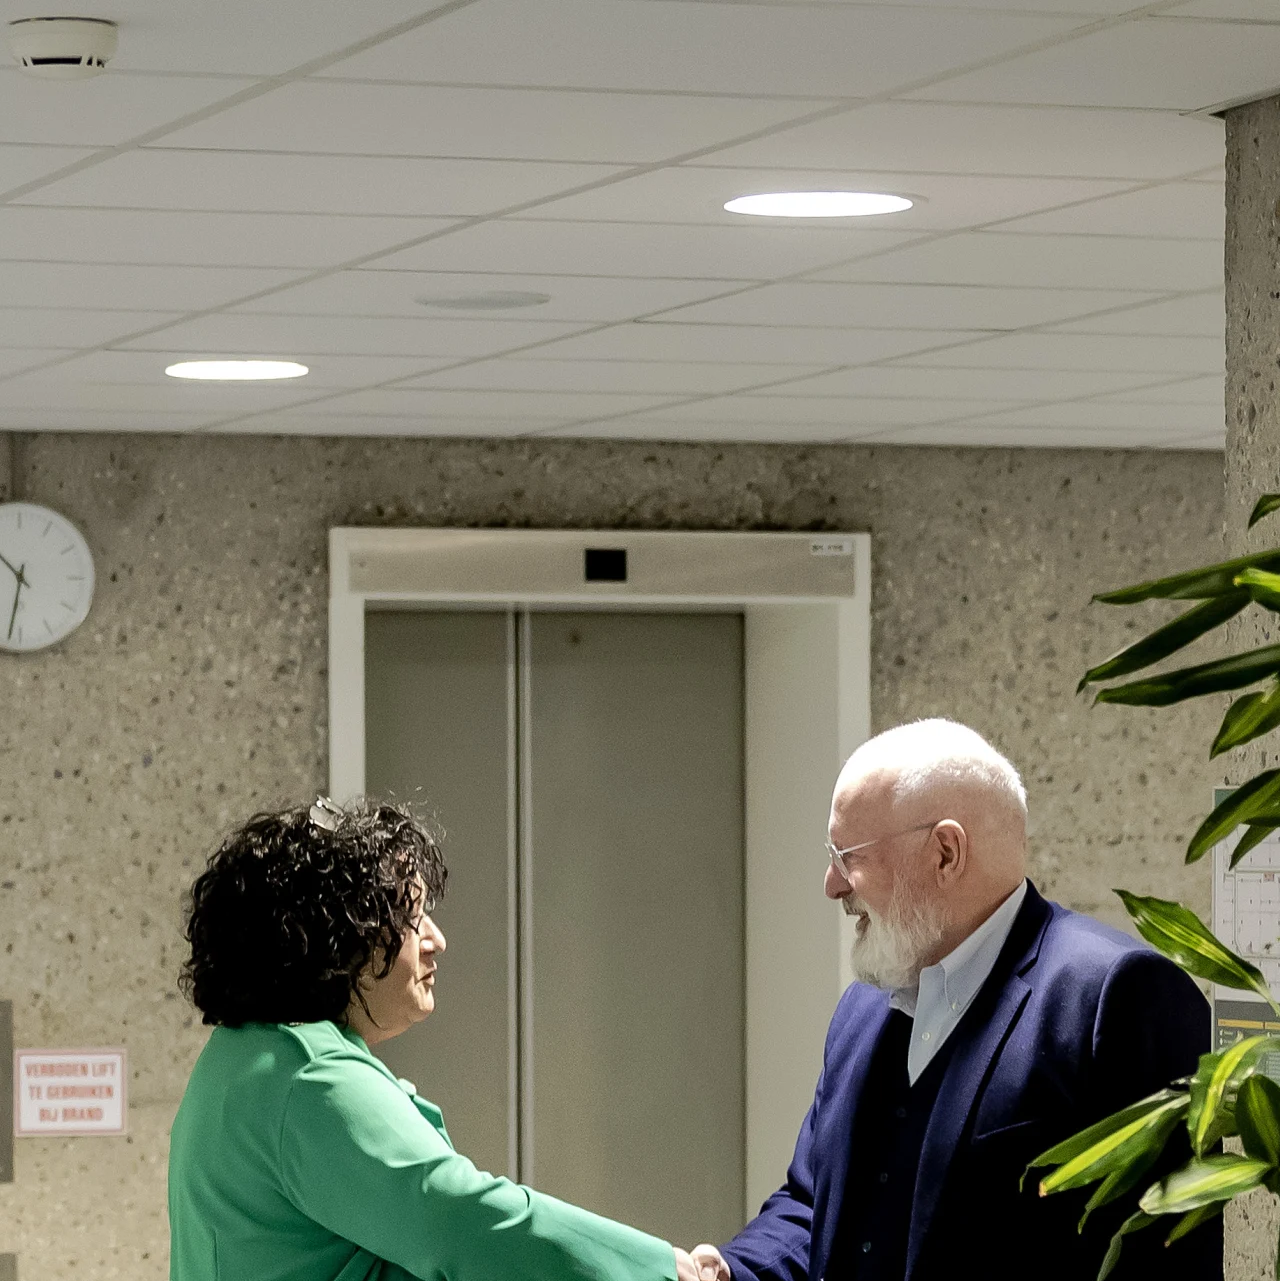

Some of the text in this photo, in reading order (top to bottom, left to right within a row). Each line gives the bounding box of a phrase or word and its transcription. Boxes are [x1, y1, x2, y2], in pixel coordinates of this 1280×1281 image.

[92, 1063, 117, 1077] LIFT
[29, 1085, 42, 1099] TE
[39, 1108, 103, 1122] BIJ BRAND
